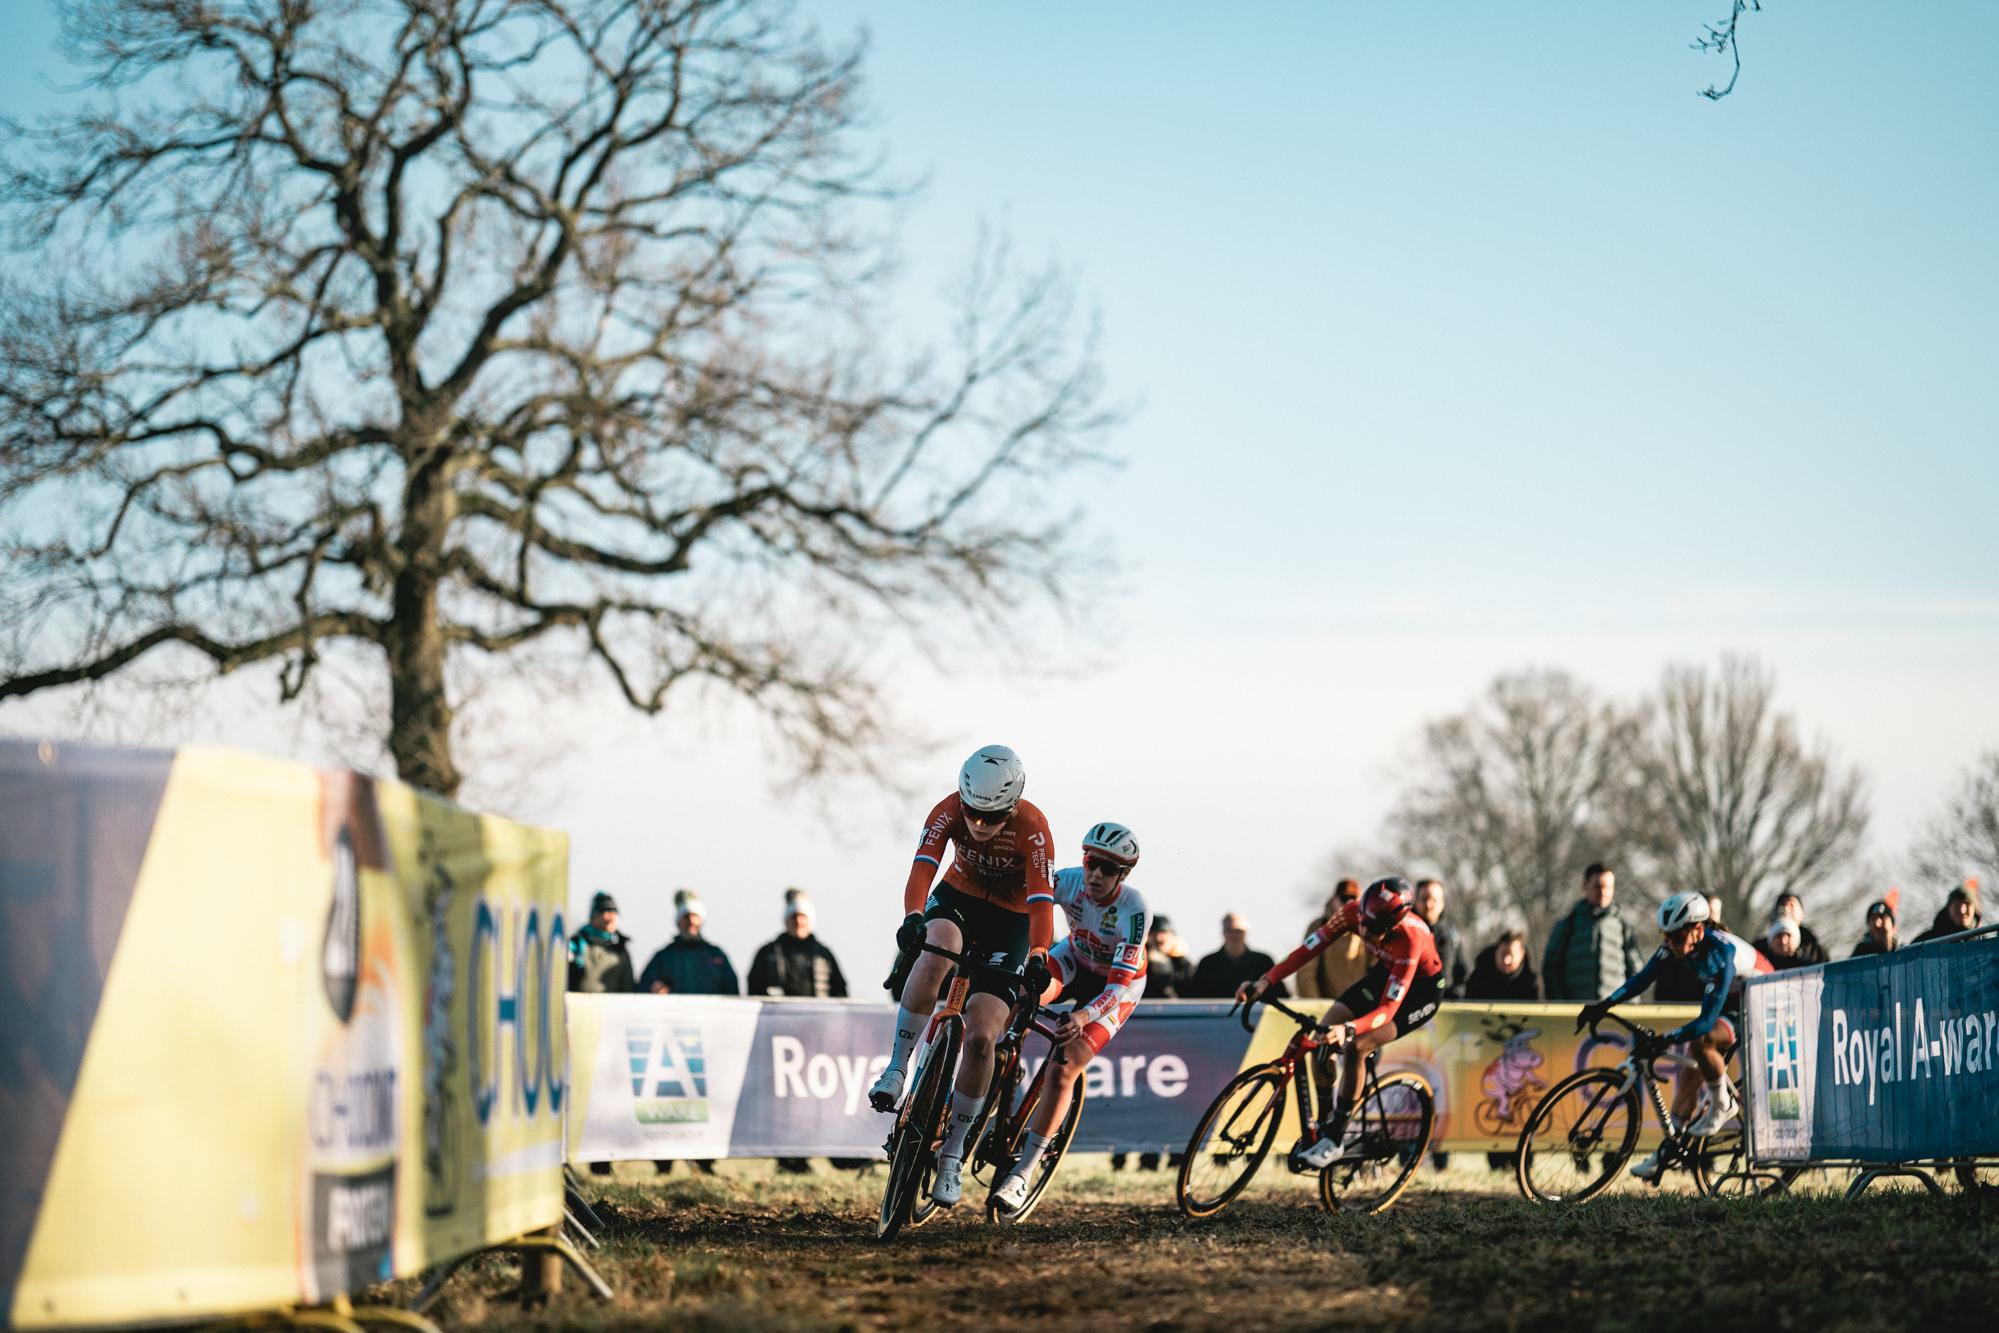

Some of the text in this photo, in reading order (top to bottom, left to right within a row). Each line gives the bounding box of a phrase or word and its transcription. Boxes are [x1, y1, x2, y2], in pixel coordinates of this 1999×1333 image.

[925, 811, 953, 846] FENIX
[957, 843, 1016, 869] FENIX
[1038, 848, 1047, 878] PREMIER
[1135, 912, 1145, 945] ALTEZ
[1407, 1001, 1437, 1025] SEVEN
[1832, 1001, 1902, 1106] Royal
[1910, 997, 1999, 1080] A-war
[772, 1035, 893, 1116] Roy
